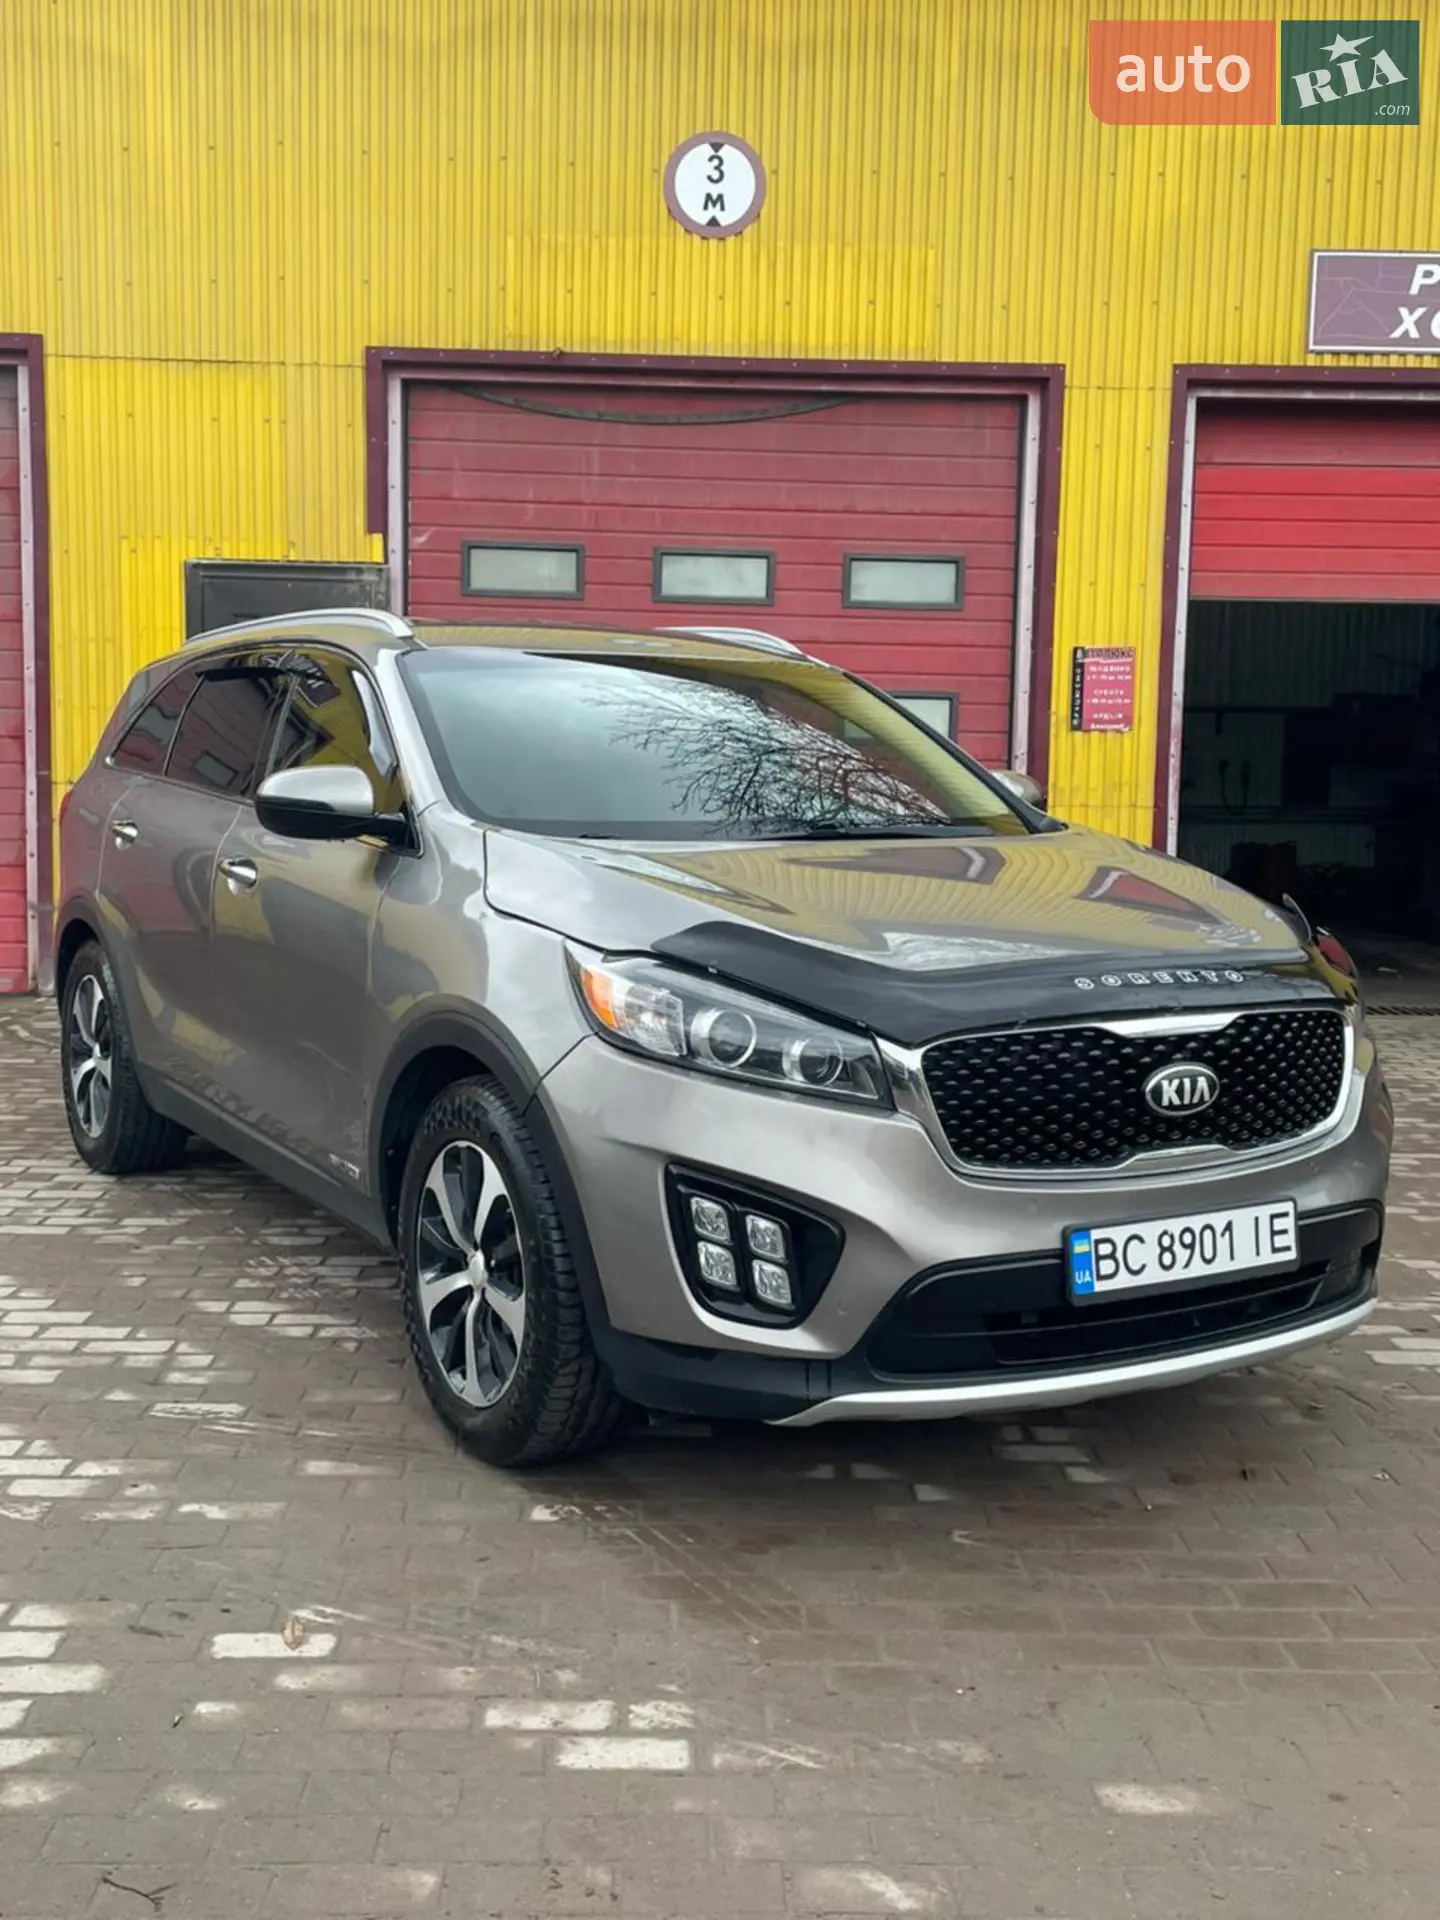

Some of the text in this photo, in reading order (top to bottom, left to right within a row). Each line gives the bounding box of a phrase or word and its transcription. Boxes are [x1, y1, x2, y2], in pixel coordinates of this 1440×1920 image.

[706, 154, 725, 184] 3
[1074, 970, 1244, 990] SORENTO
[1160, 1076, 1211, 1107] KIA
[1093, 1211, 1293, 1282] BC 8901 IE
[1075, 1269, 1092, 1285] UA
